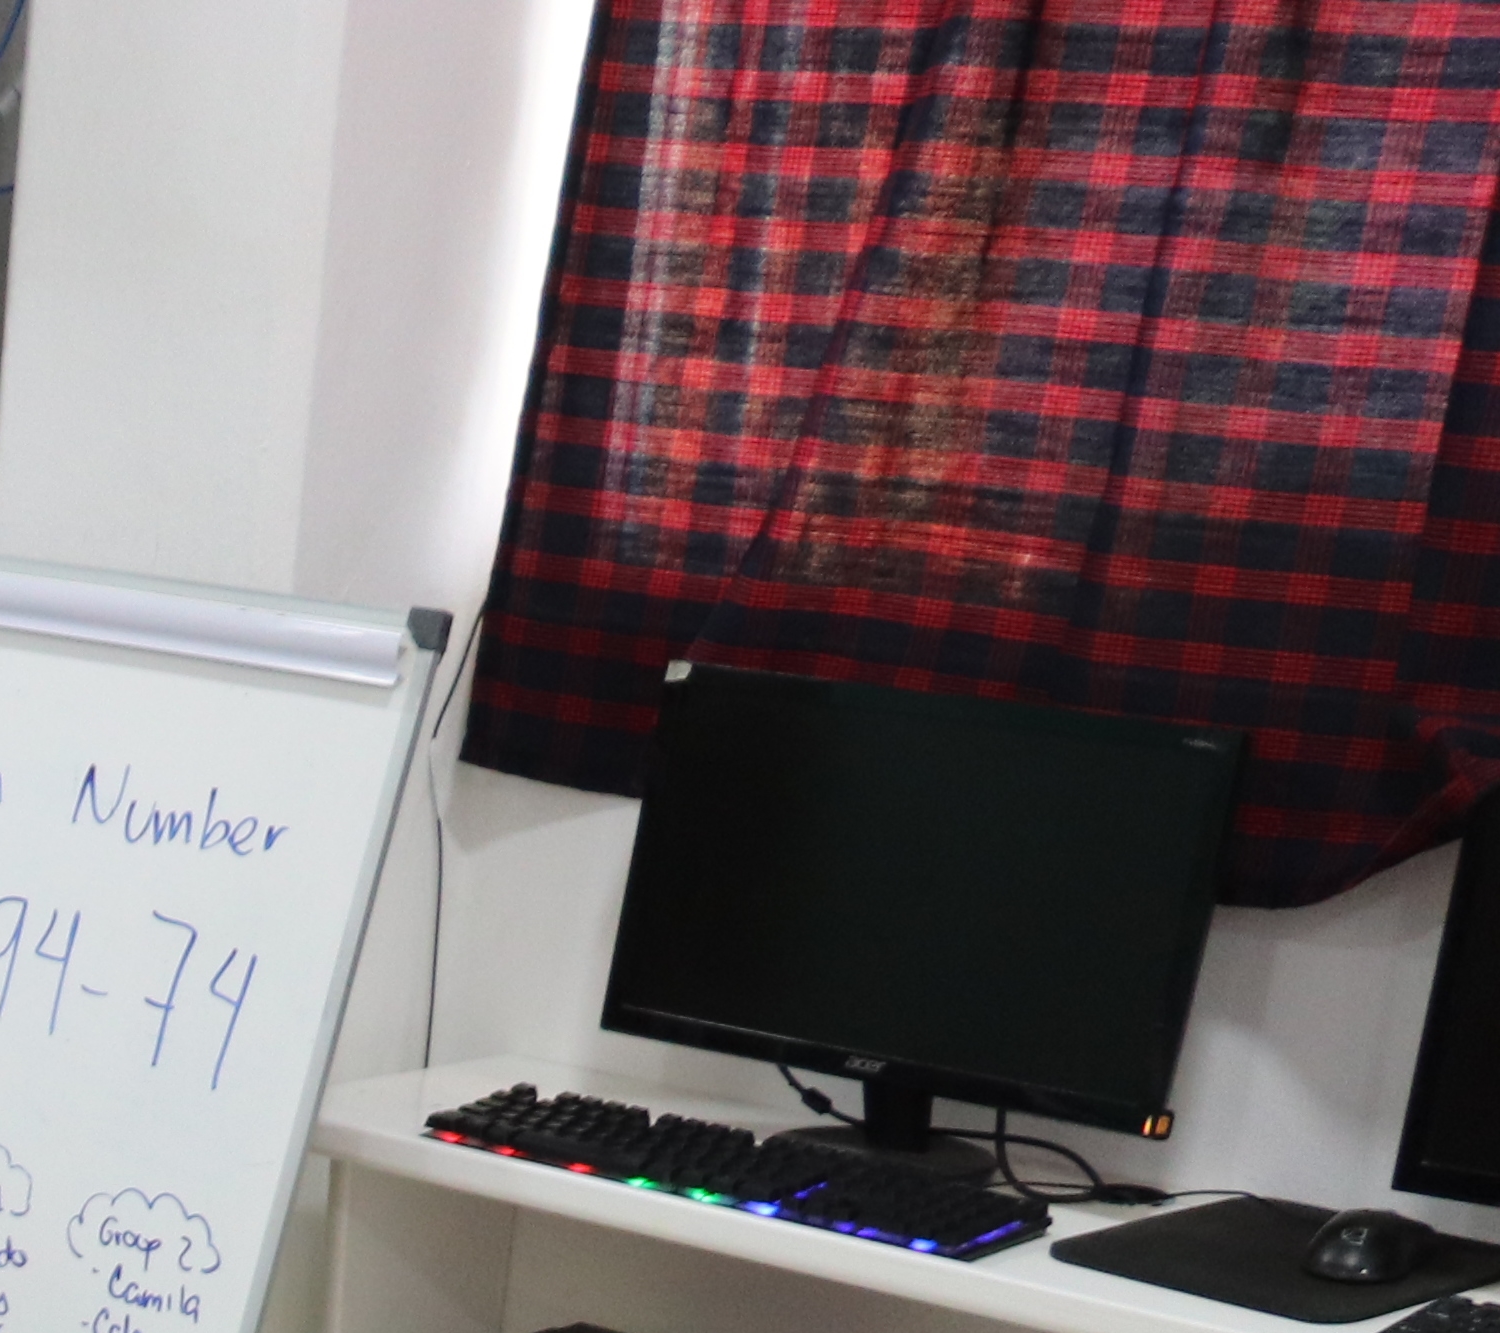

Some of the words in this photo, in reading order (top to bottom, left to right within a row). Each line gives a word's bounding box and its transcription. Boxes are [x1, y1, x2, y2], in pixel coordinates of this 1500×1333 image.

[71, 762, 290, 857] Number
[99, 1215, 162, 1272] Group
[178, 1235, 193, 1272] 2
[108, 1263, 201, 1325] Camila
